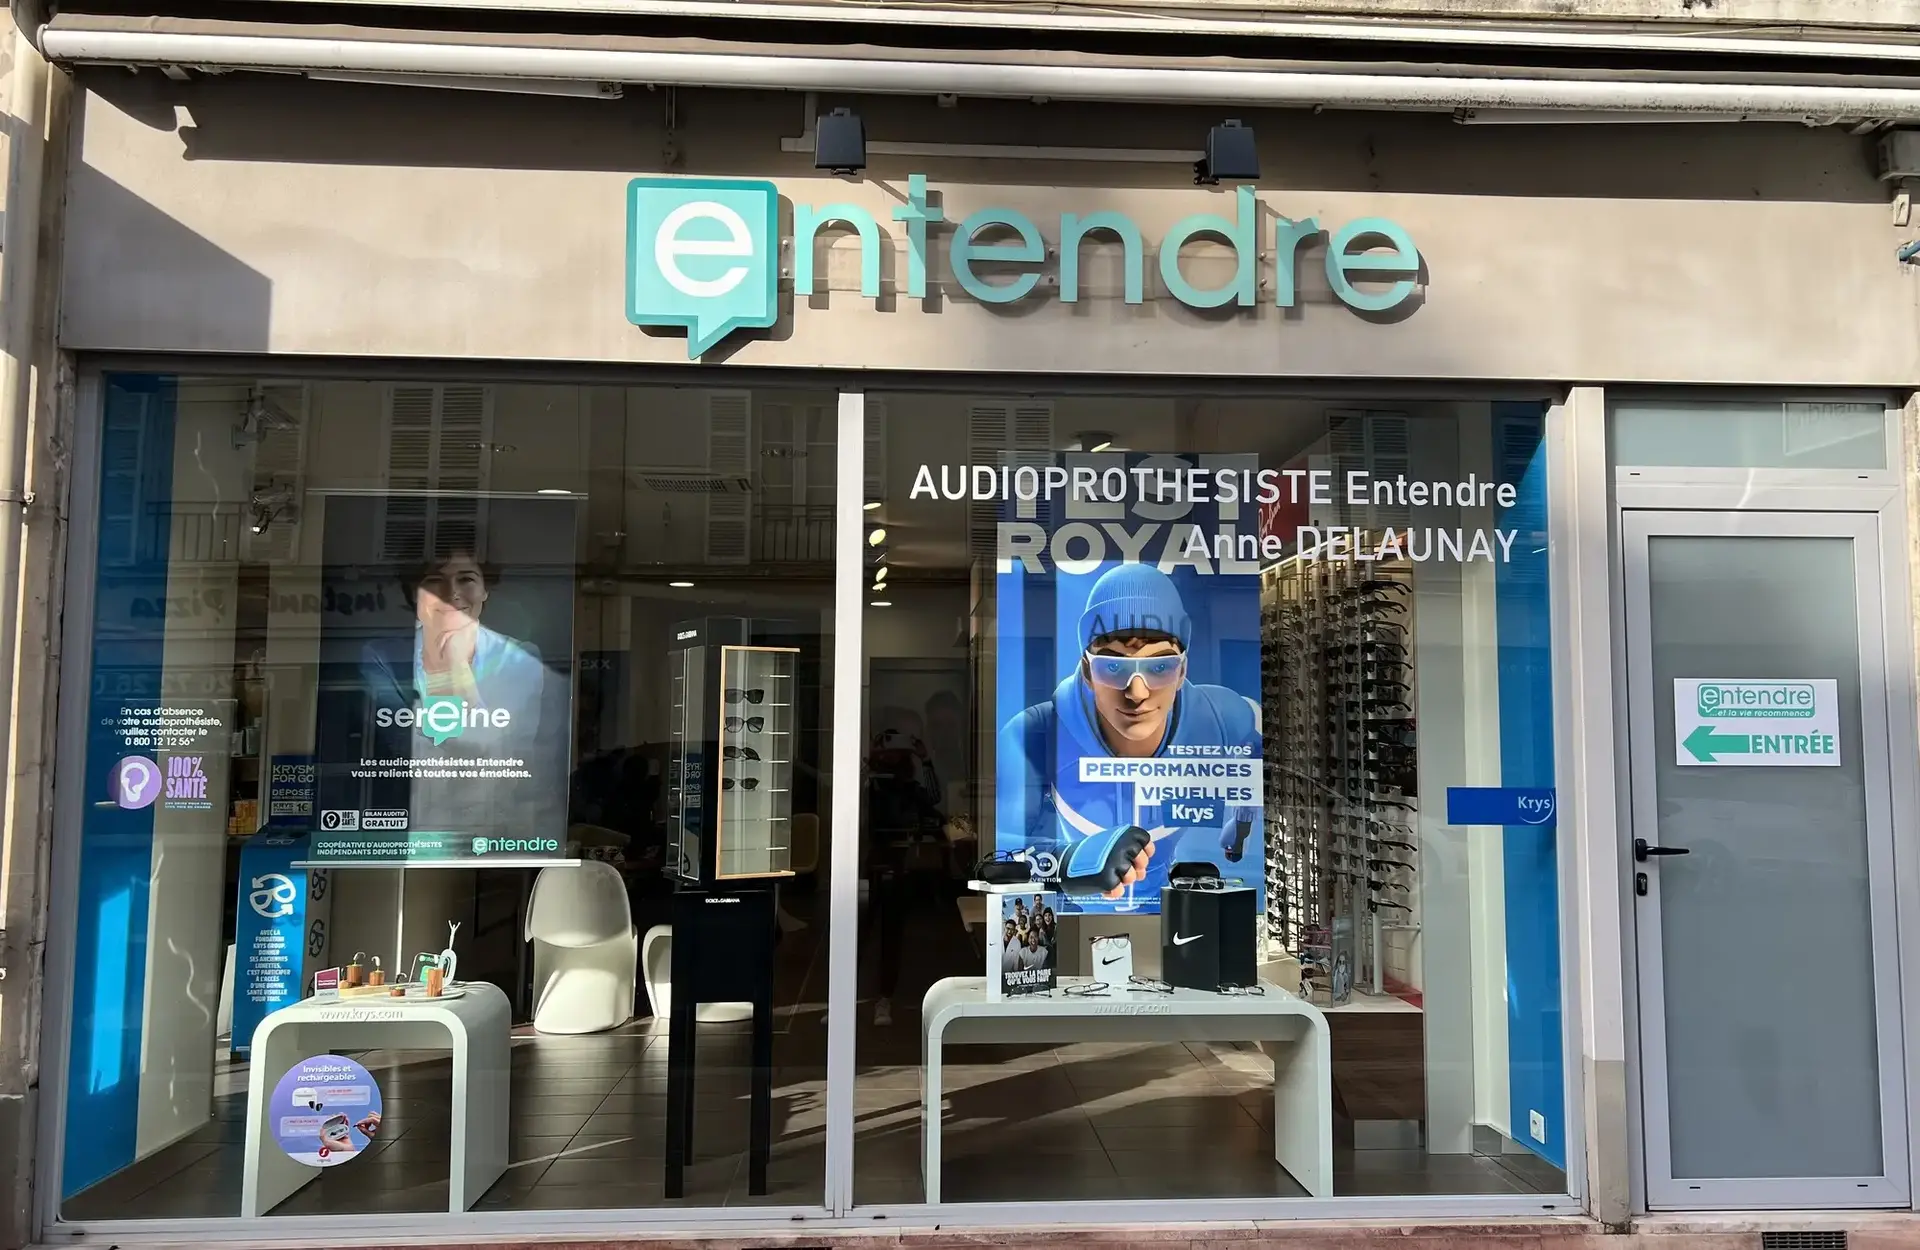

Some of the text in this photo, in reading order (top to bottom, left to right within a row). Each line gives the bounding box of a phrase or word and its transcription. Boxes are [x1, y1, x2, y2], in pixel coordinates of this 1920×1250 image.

[652, 172, 1421, 313] entendre
[909, 464, 1517, 508] AUDIOPROTHESISTE Entendre
[997, 522, 1260, 576] ROYAL
[1183, 524, 1519, 563] Anne DELAUNAY
[1702, 686, 1812, 706] entendre
[120, 706, 204, 716] En cas d'absence
[375, 700, 511, 733] sereine
[1739, 709, 1752, 717] vie
[1754, 709, 1812, 718] recommence
[101, 717, 222, 727] de votre audioprothésiste,
[150, 727, 197, 736] contacter
[198, 727, 208, 736] le
[125, 737, 132, 746] 0
[133, 737, 151, 746] 800
[153, 737, 164, 746] 12
[166, 737, 177, 746] 12
[1751, 729, 1835, 754] ENTRÉE
[1167, 744, 1252, 756] TESTEZ VOS
[167, 756, 204, 778] 100%
[360, 757, 524, 769] Les audioprothésistes Entendre
[1085, 762, 1252, 778] PERFORMANCES
[350, 768, 532, 778] vous relient à toutes vos émotions.
[166, 776, 208, 799] SANTÉ
[1517, 796, 1551, 813] Krys
[1171, 803, 1215, 823] Krys
[364, 819, 405, 828] GRATUIT
[317, 840, 443, 849] COOPÉRATIVE D'AUDIOPROTHÉSISTES
[317, 847, 372, 856] INDÉPENDANTS
[372, 848, 398, 856] DEPUIS
[473, 836, 559, 853] entendre
[319, 1007, 404, 1023] www.krys.com
[1092, 998, 1171, 1016] www.krys.com
[302, 1064, 352, 1074] Invisibles et
[296, 1072, 357, 1083] rechargeables
